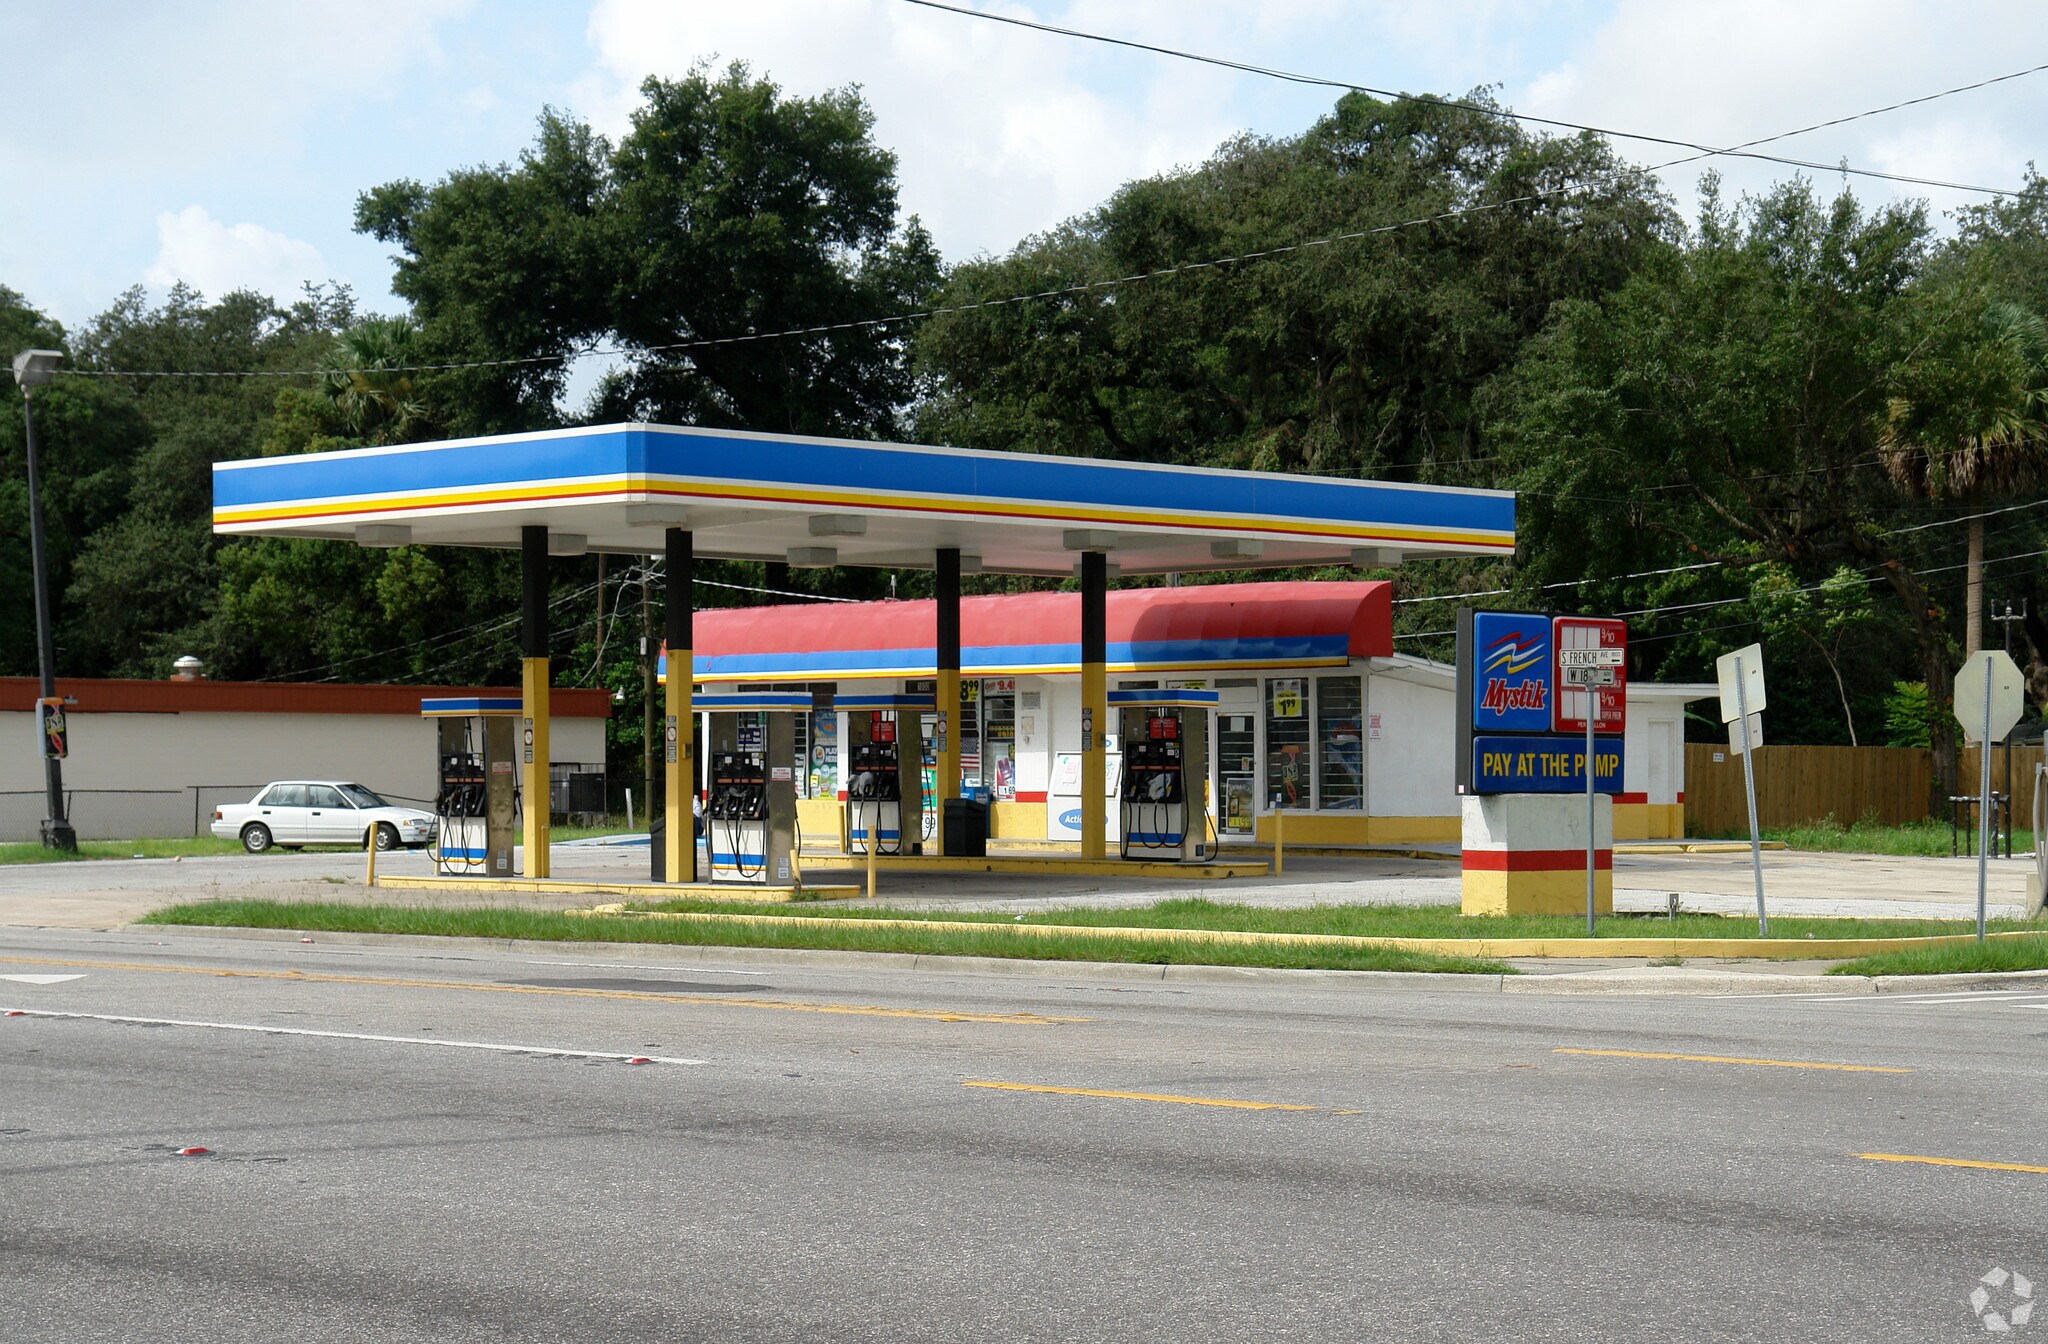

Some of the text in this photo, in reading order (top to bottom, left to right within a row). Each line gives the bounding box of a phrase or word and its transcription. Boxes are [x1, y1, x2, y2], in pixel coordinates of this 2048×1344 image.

[1562, 652, 1567, 664] S
[1570, 652, 1597, 664] FRENCH
[1570, 669, 1577, 681] W
[1481, 678, 1548, 716] Mystik
[1483, 753, 1512, 777] PAY
[1517, 753, 1536, 777] AT
[1540, 754, 1569, 777] THE
